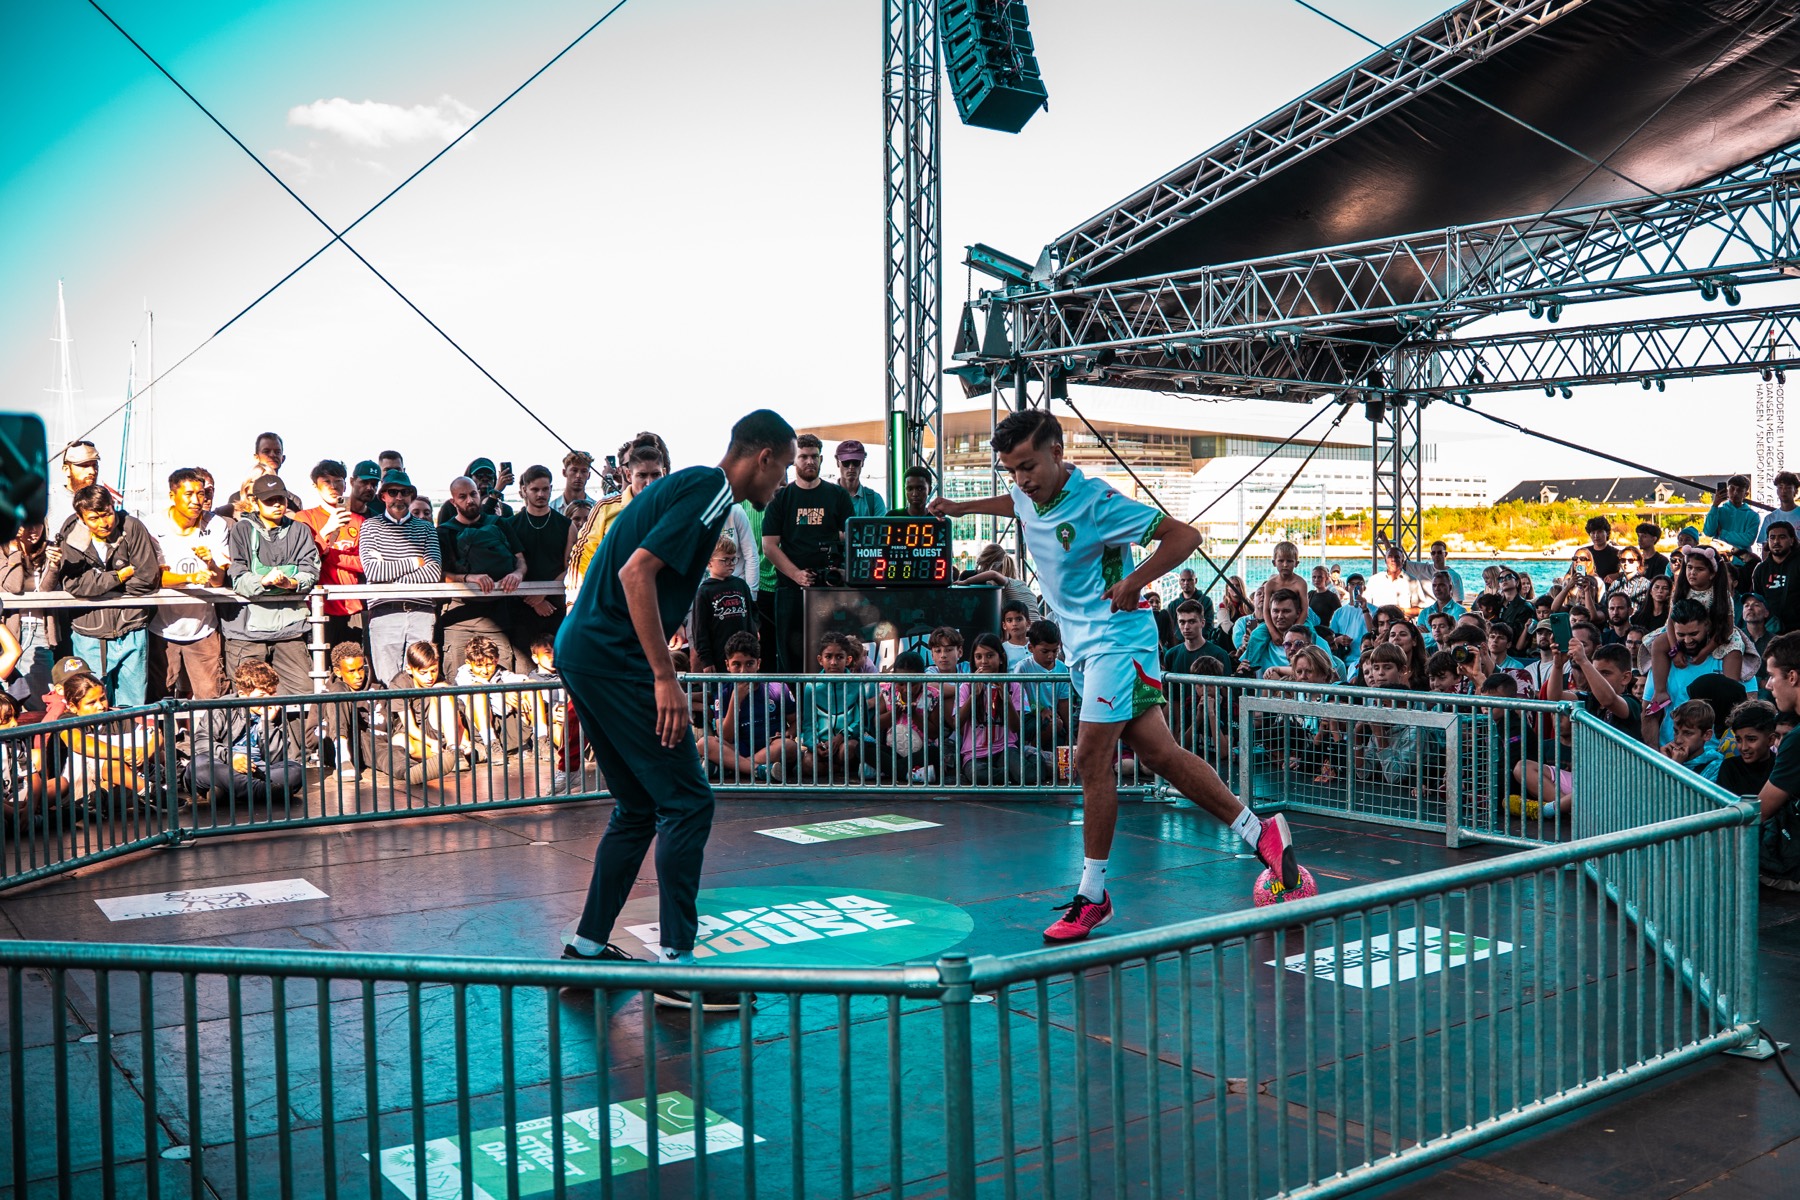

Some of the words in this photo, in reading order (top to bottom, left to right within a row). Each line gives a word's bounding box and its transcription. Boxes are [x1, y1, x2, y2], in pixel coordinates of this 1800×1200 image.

[1756, 384, 1764, 421] HANSEN
[1766, 383, 1774, 421] DANSEN
[1766, 423, 1774, 443] MED
[1766, 445, 1774, 483] REGITZE
[886, 524, 934, 547] 1:05
[856, 548, 883, 558] HOME
[912, 548, 942, 558] GUEST
[873, 559, 887, 579] 2
[934, 559, 946, 579] 3
[141, 907, 203, 918] novo
[210, 896, 295, 910] nordisk
[515, 1118, 552, 1130] 202
